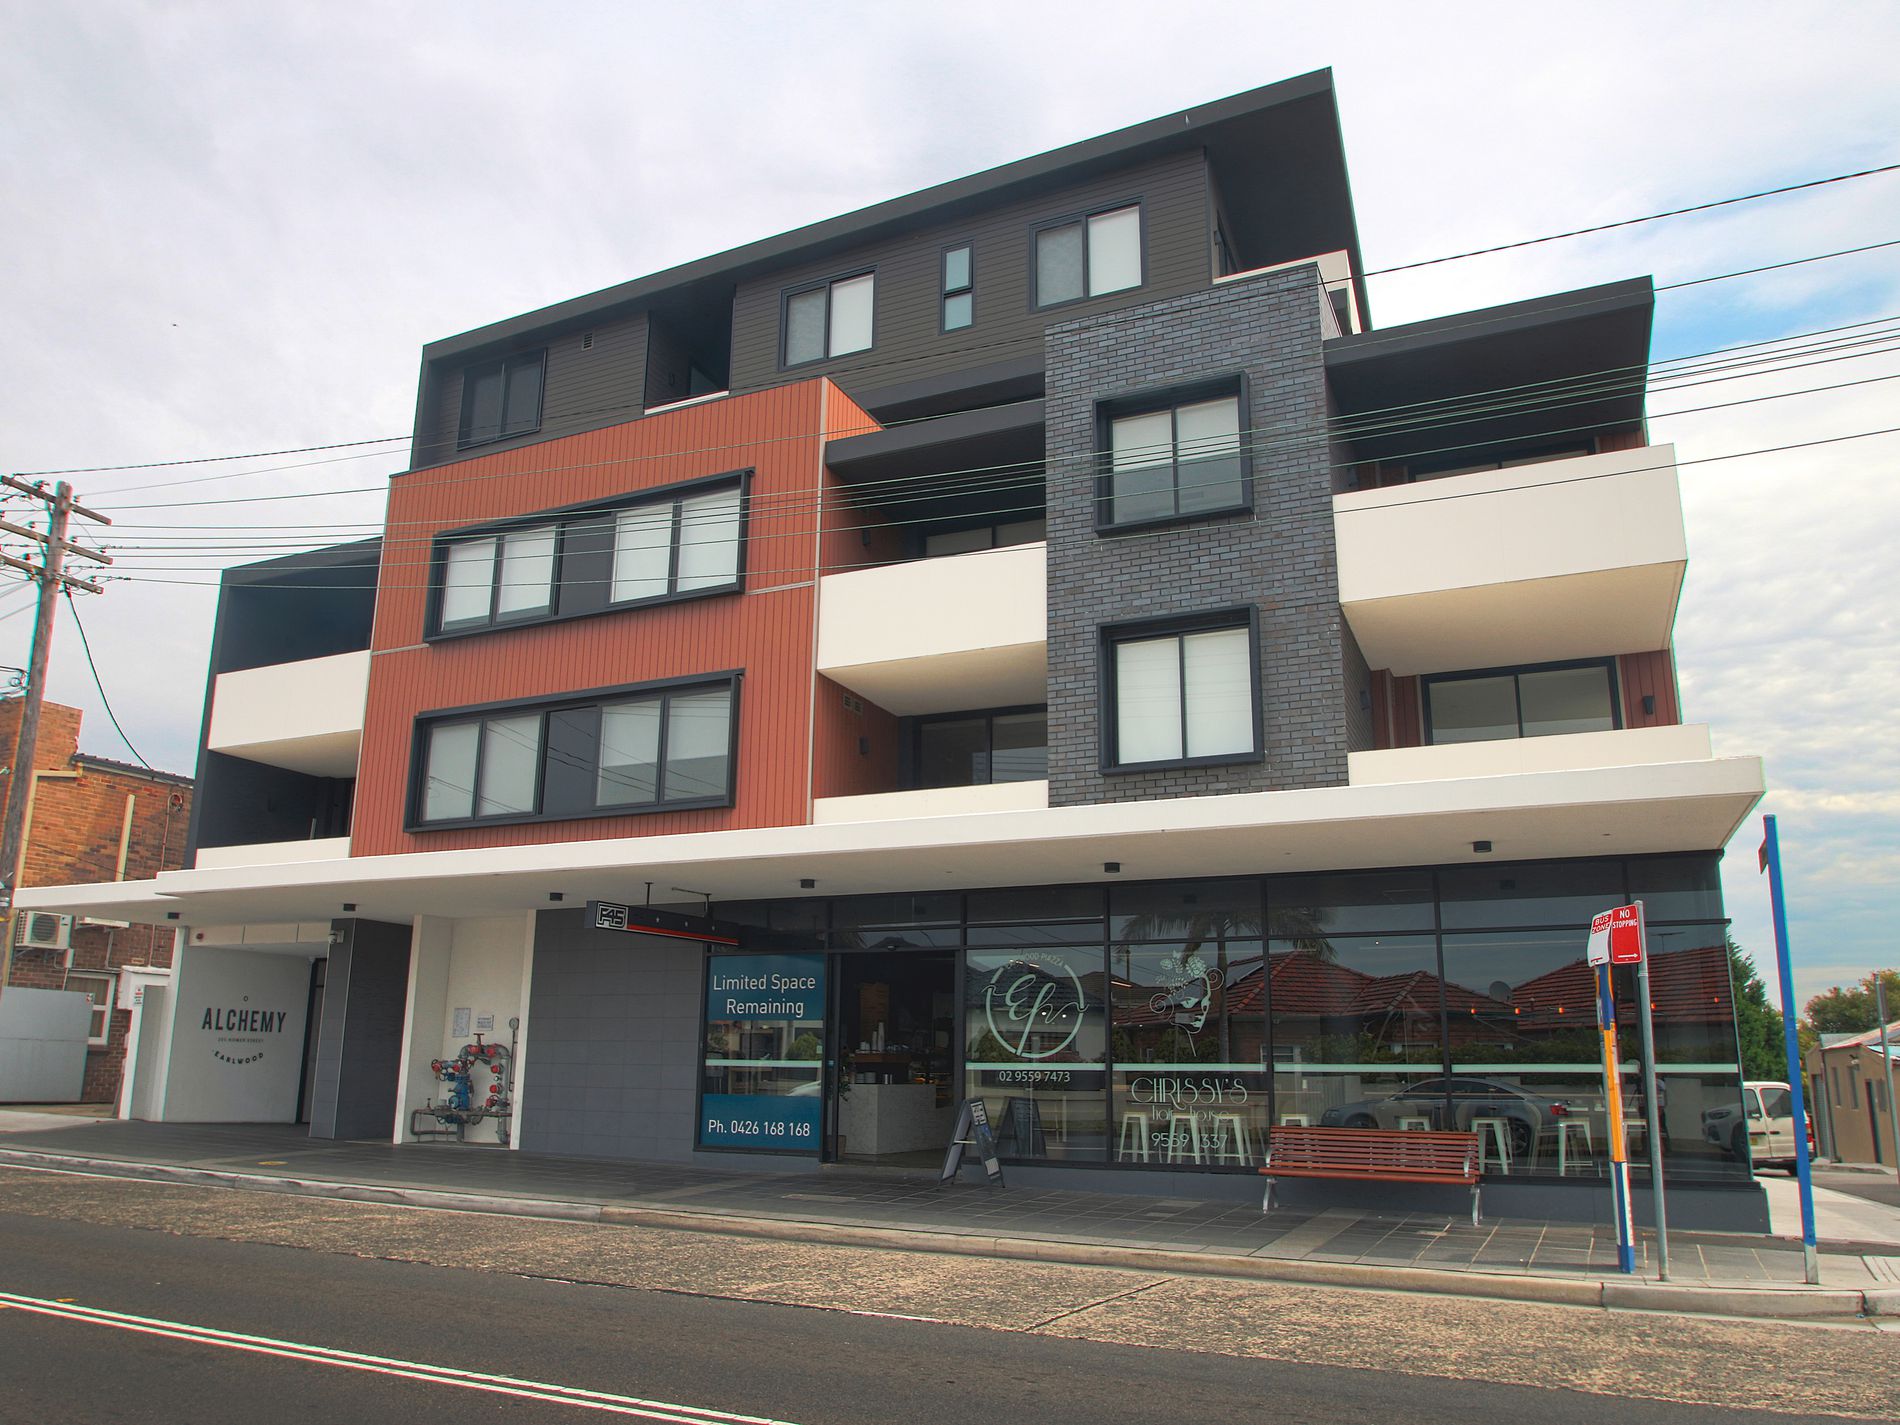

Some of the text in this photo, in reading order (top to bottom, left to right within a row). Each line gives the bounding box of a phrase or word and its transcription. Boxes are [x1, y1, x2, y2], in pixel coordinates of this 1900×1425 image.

[597, 903, 628, 929] F45
[1594, 915, 1609, 926] BUS
[1619, 909, 1630, 918] NO
[1592, 922, 1610, 934] ZONE
[1612, 918, 1637, 928] STOPPING
[713, 973, 816, 993] Limited Space
[726, 998, 804, 1018] Remaining
[202, 1007, 287, 1033] ALCHEMY
[214, 1050, 264, 1065] EARLWOOD
[999, 1071, 1071, 1083] 02 9559 7473
[708, 1119, 811, 1137] Ph. 0426 168 168
